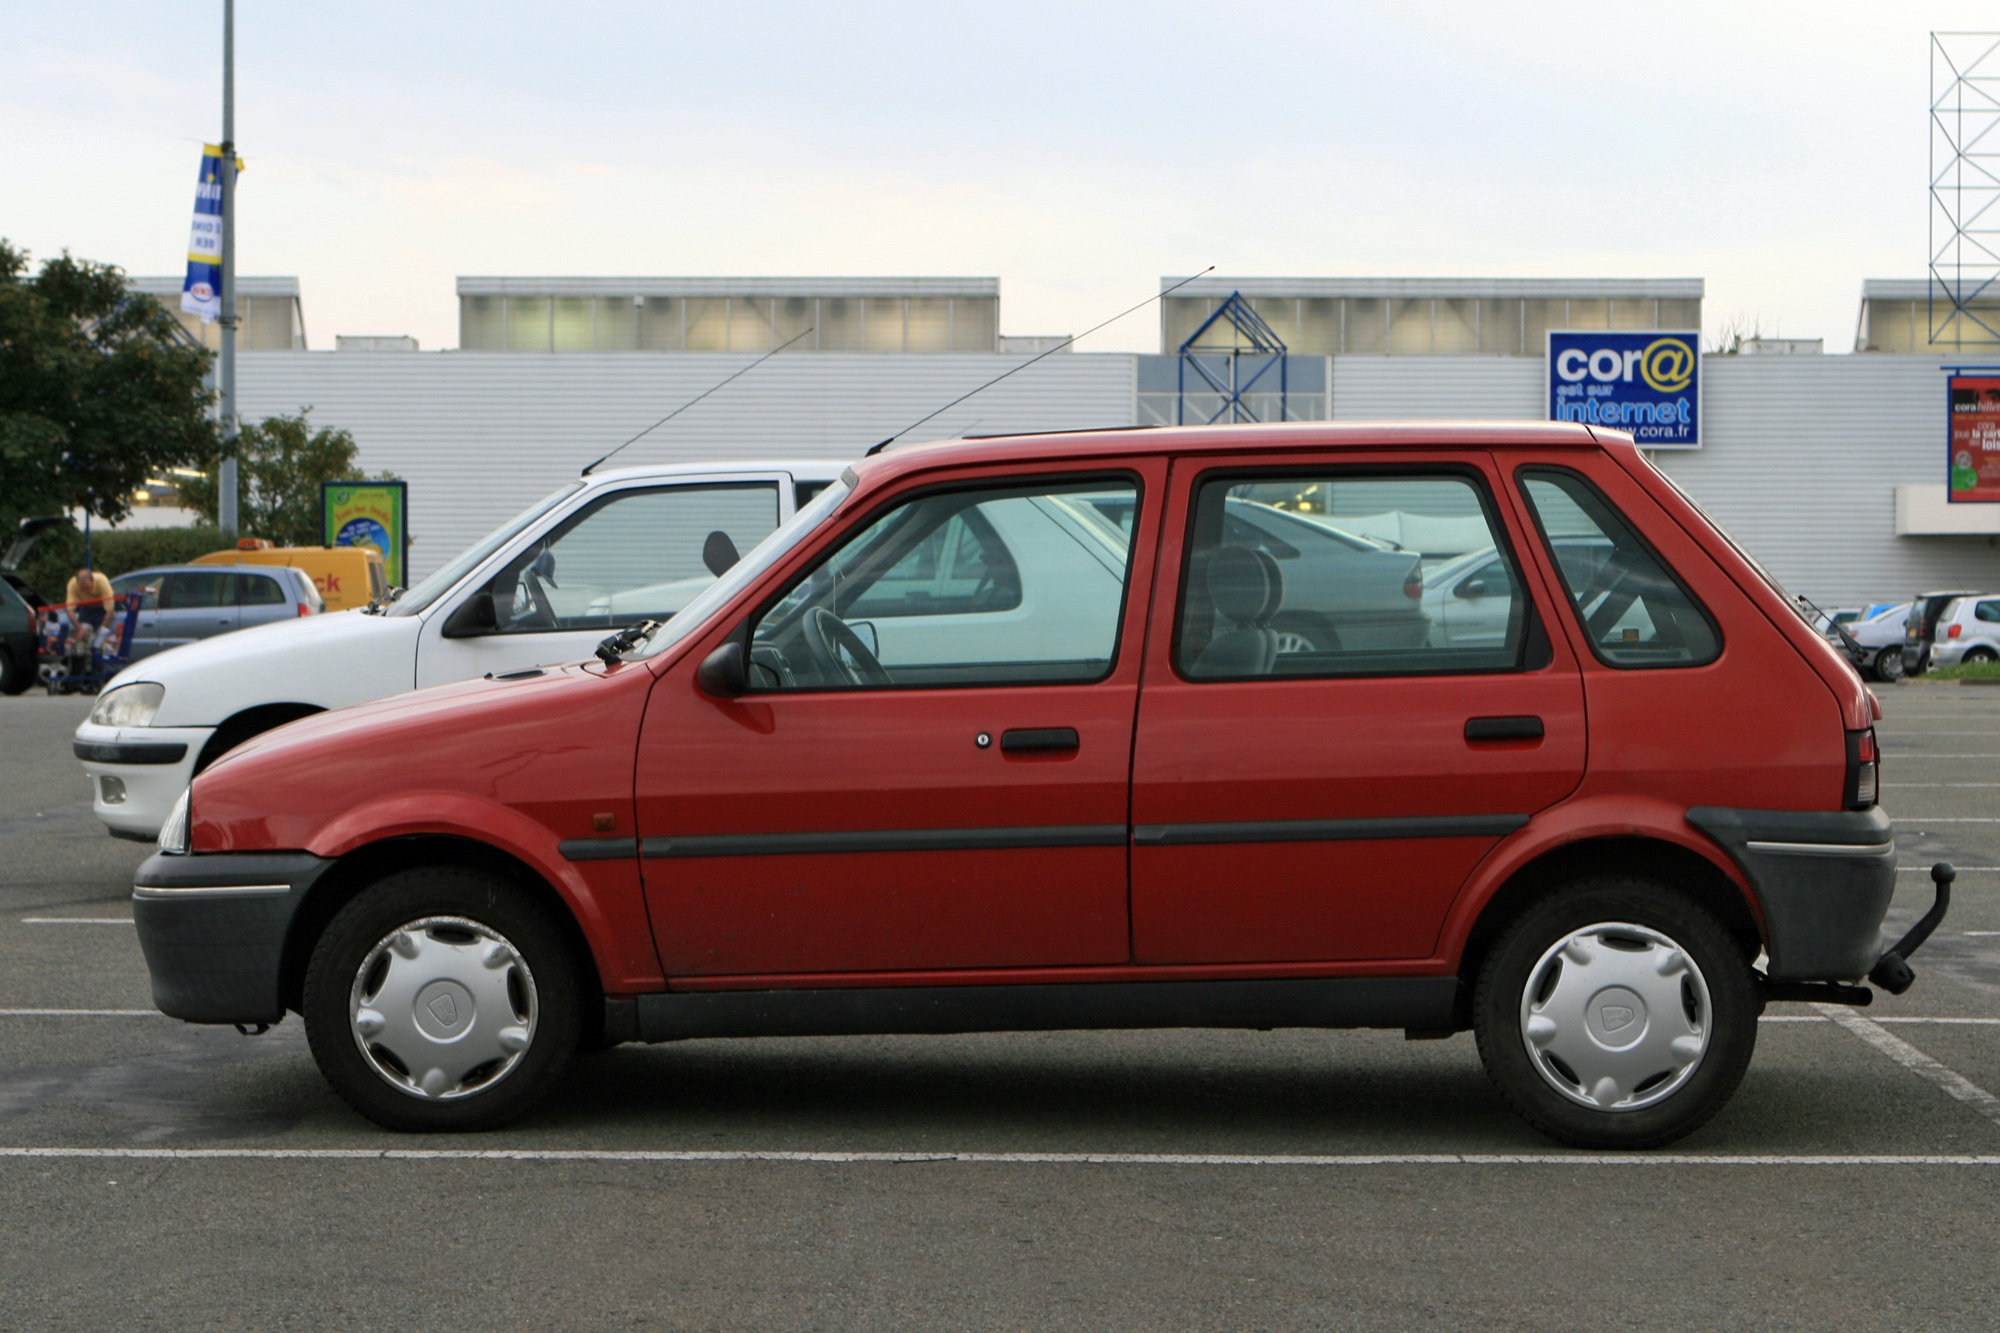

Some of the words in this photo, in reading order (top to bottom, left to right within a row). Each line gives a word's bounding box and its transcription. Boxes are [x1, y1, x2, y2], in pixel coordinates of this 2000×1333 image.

[1557, 338, 1695, 393] cor@
[1557, 383, 1584, 397] est
[1587, 384, 1614, 397] sur
[1557, 397, 1691, 424] internet
